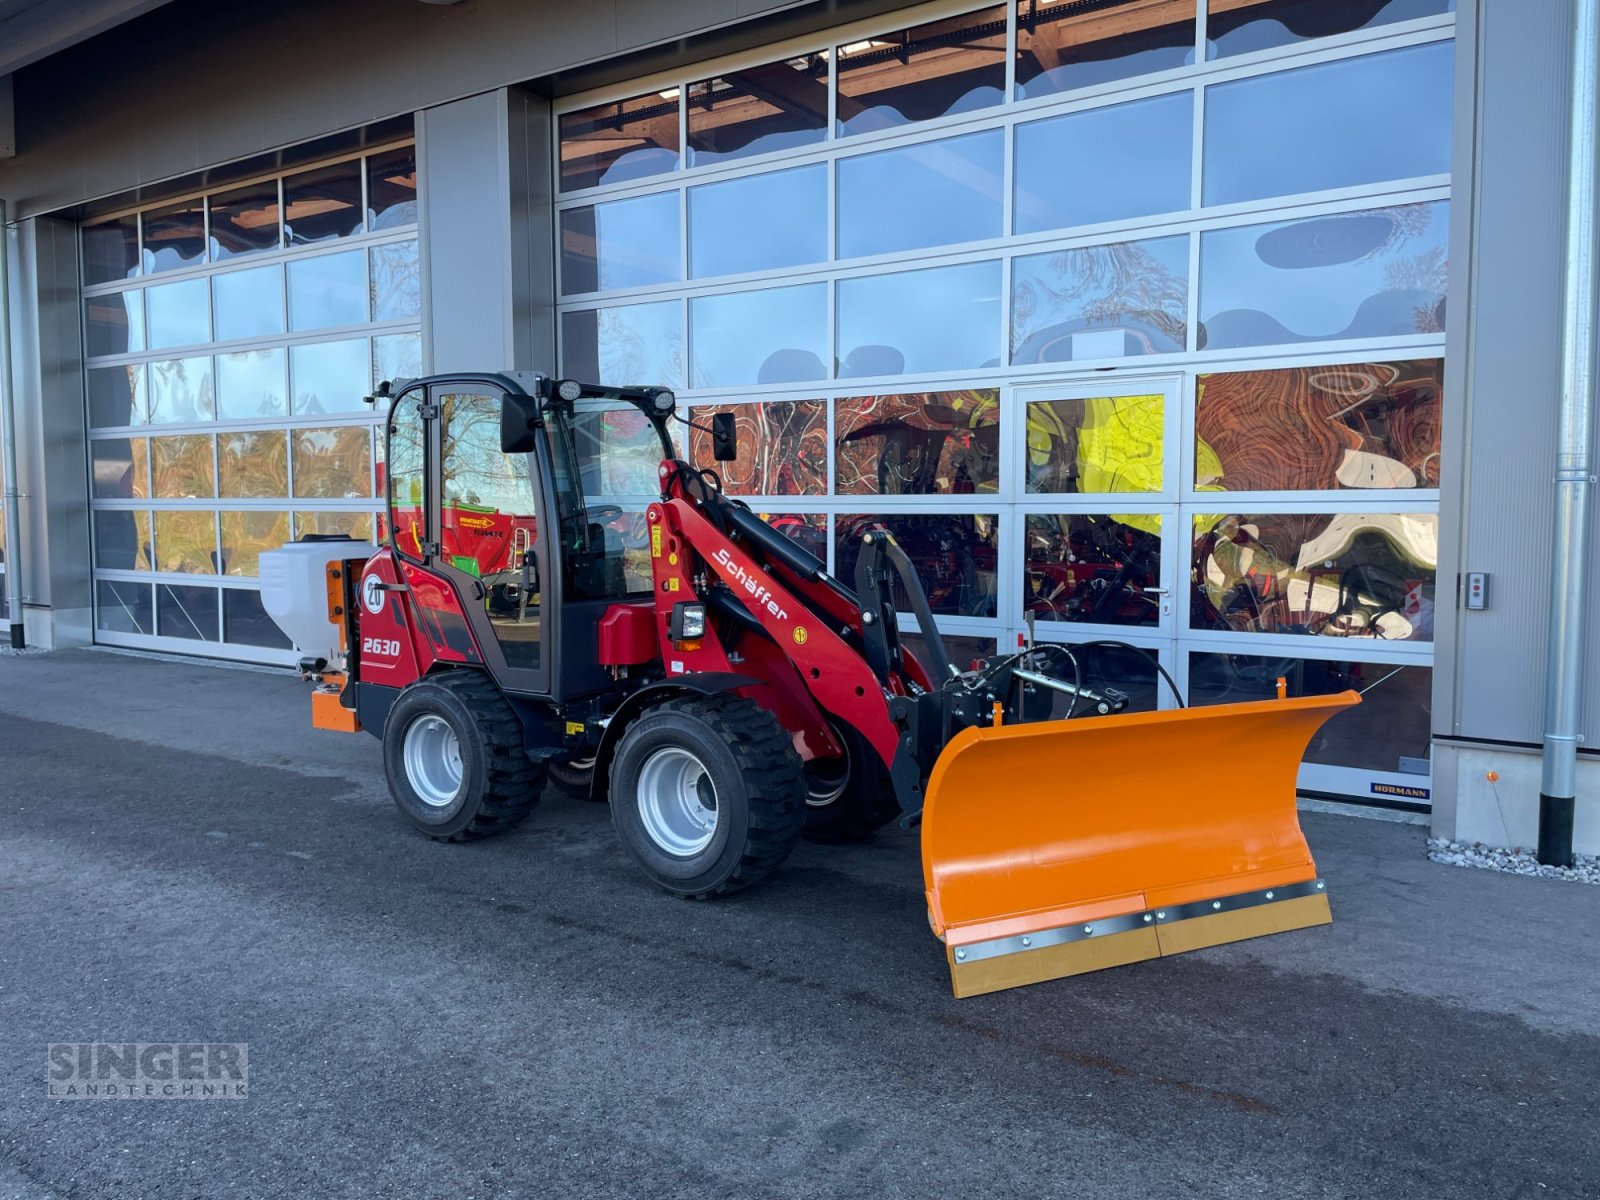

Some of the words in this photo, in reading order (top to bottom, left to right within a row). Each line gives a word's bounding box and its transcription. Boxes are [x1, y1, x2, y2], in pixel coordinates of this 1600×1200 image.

[368, 582, 381, 606] 20
[711, 548, 788, 620] Schäffer
[363, 637, 400, 656] 2630
